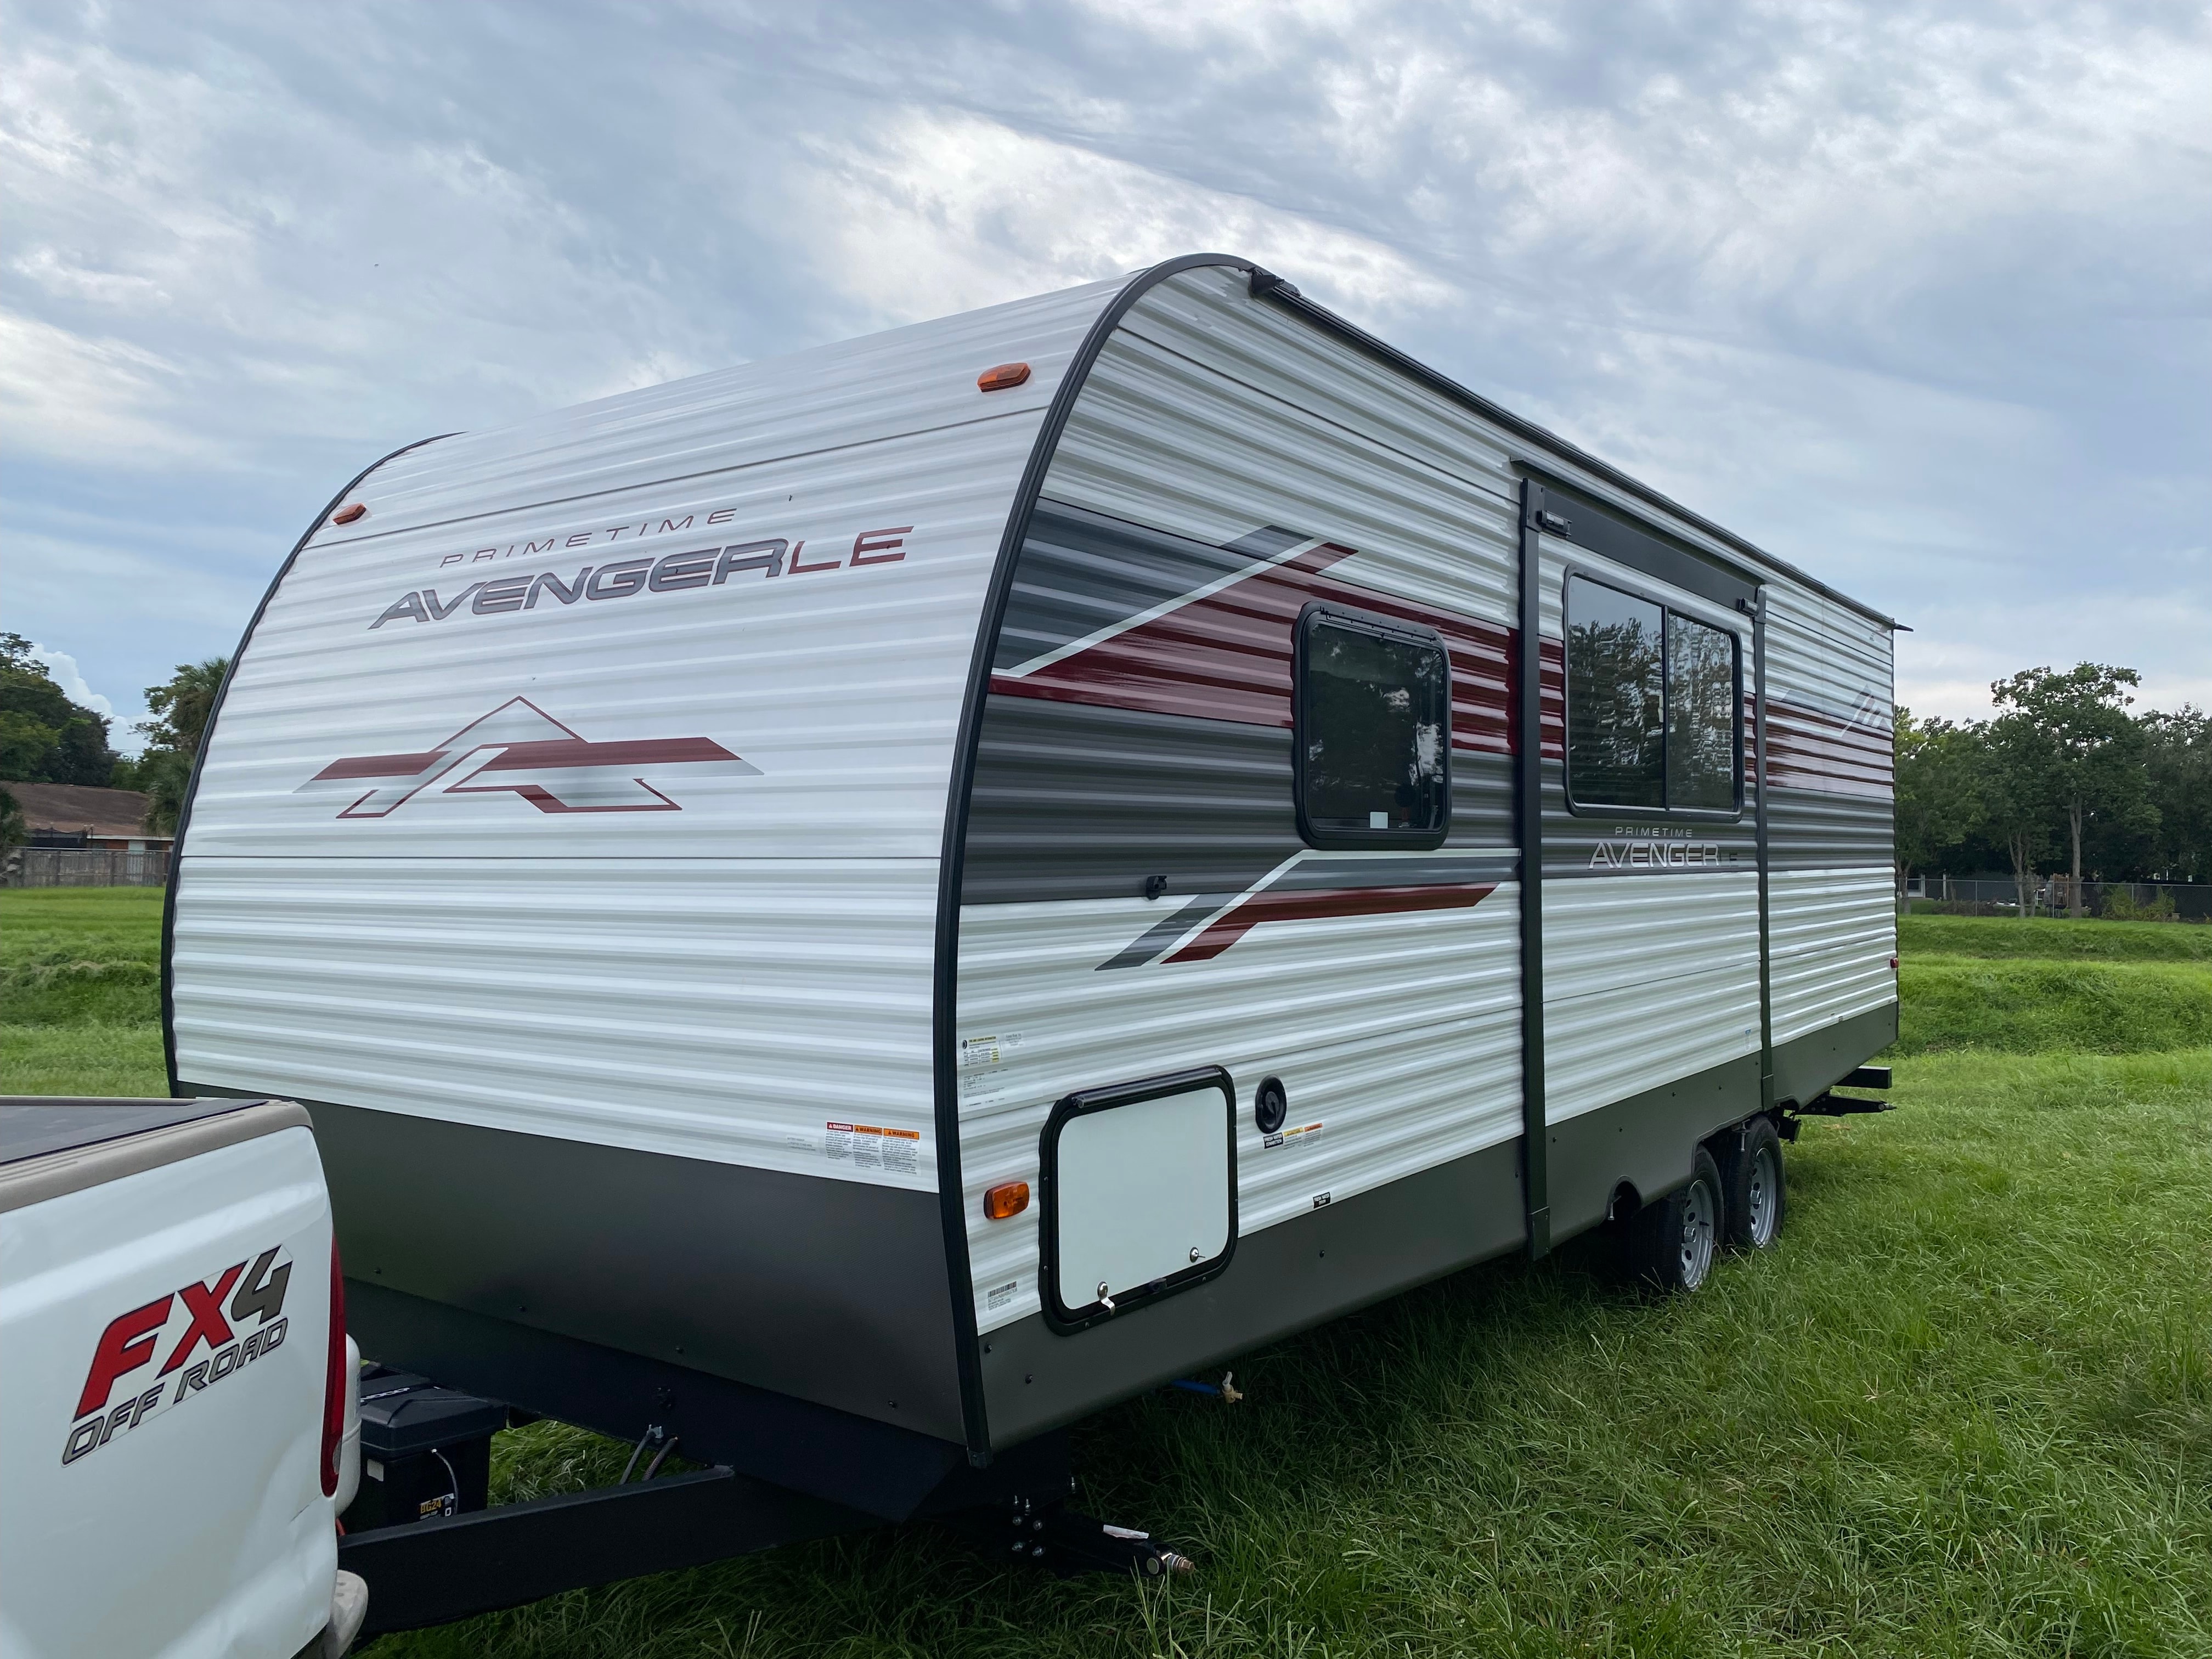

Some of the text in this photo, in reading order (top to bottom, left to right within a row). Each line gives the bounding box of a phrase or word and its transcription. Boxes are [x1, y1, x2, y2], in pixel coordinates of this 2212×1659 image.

[439, 508, 737, 568] PRIMETIME
[1615, 826, 1693, 837] PRIMETIME
[72, 1245, 293, 1423] FX4
[62, 1317, 288, 1465] OFF ROAD
